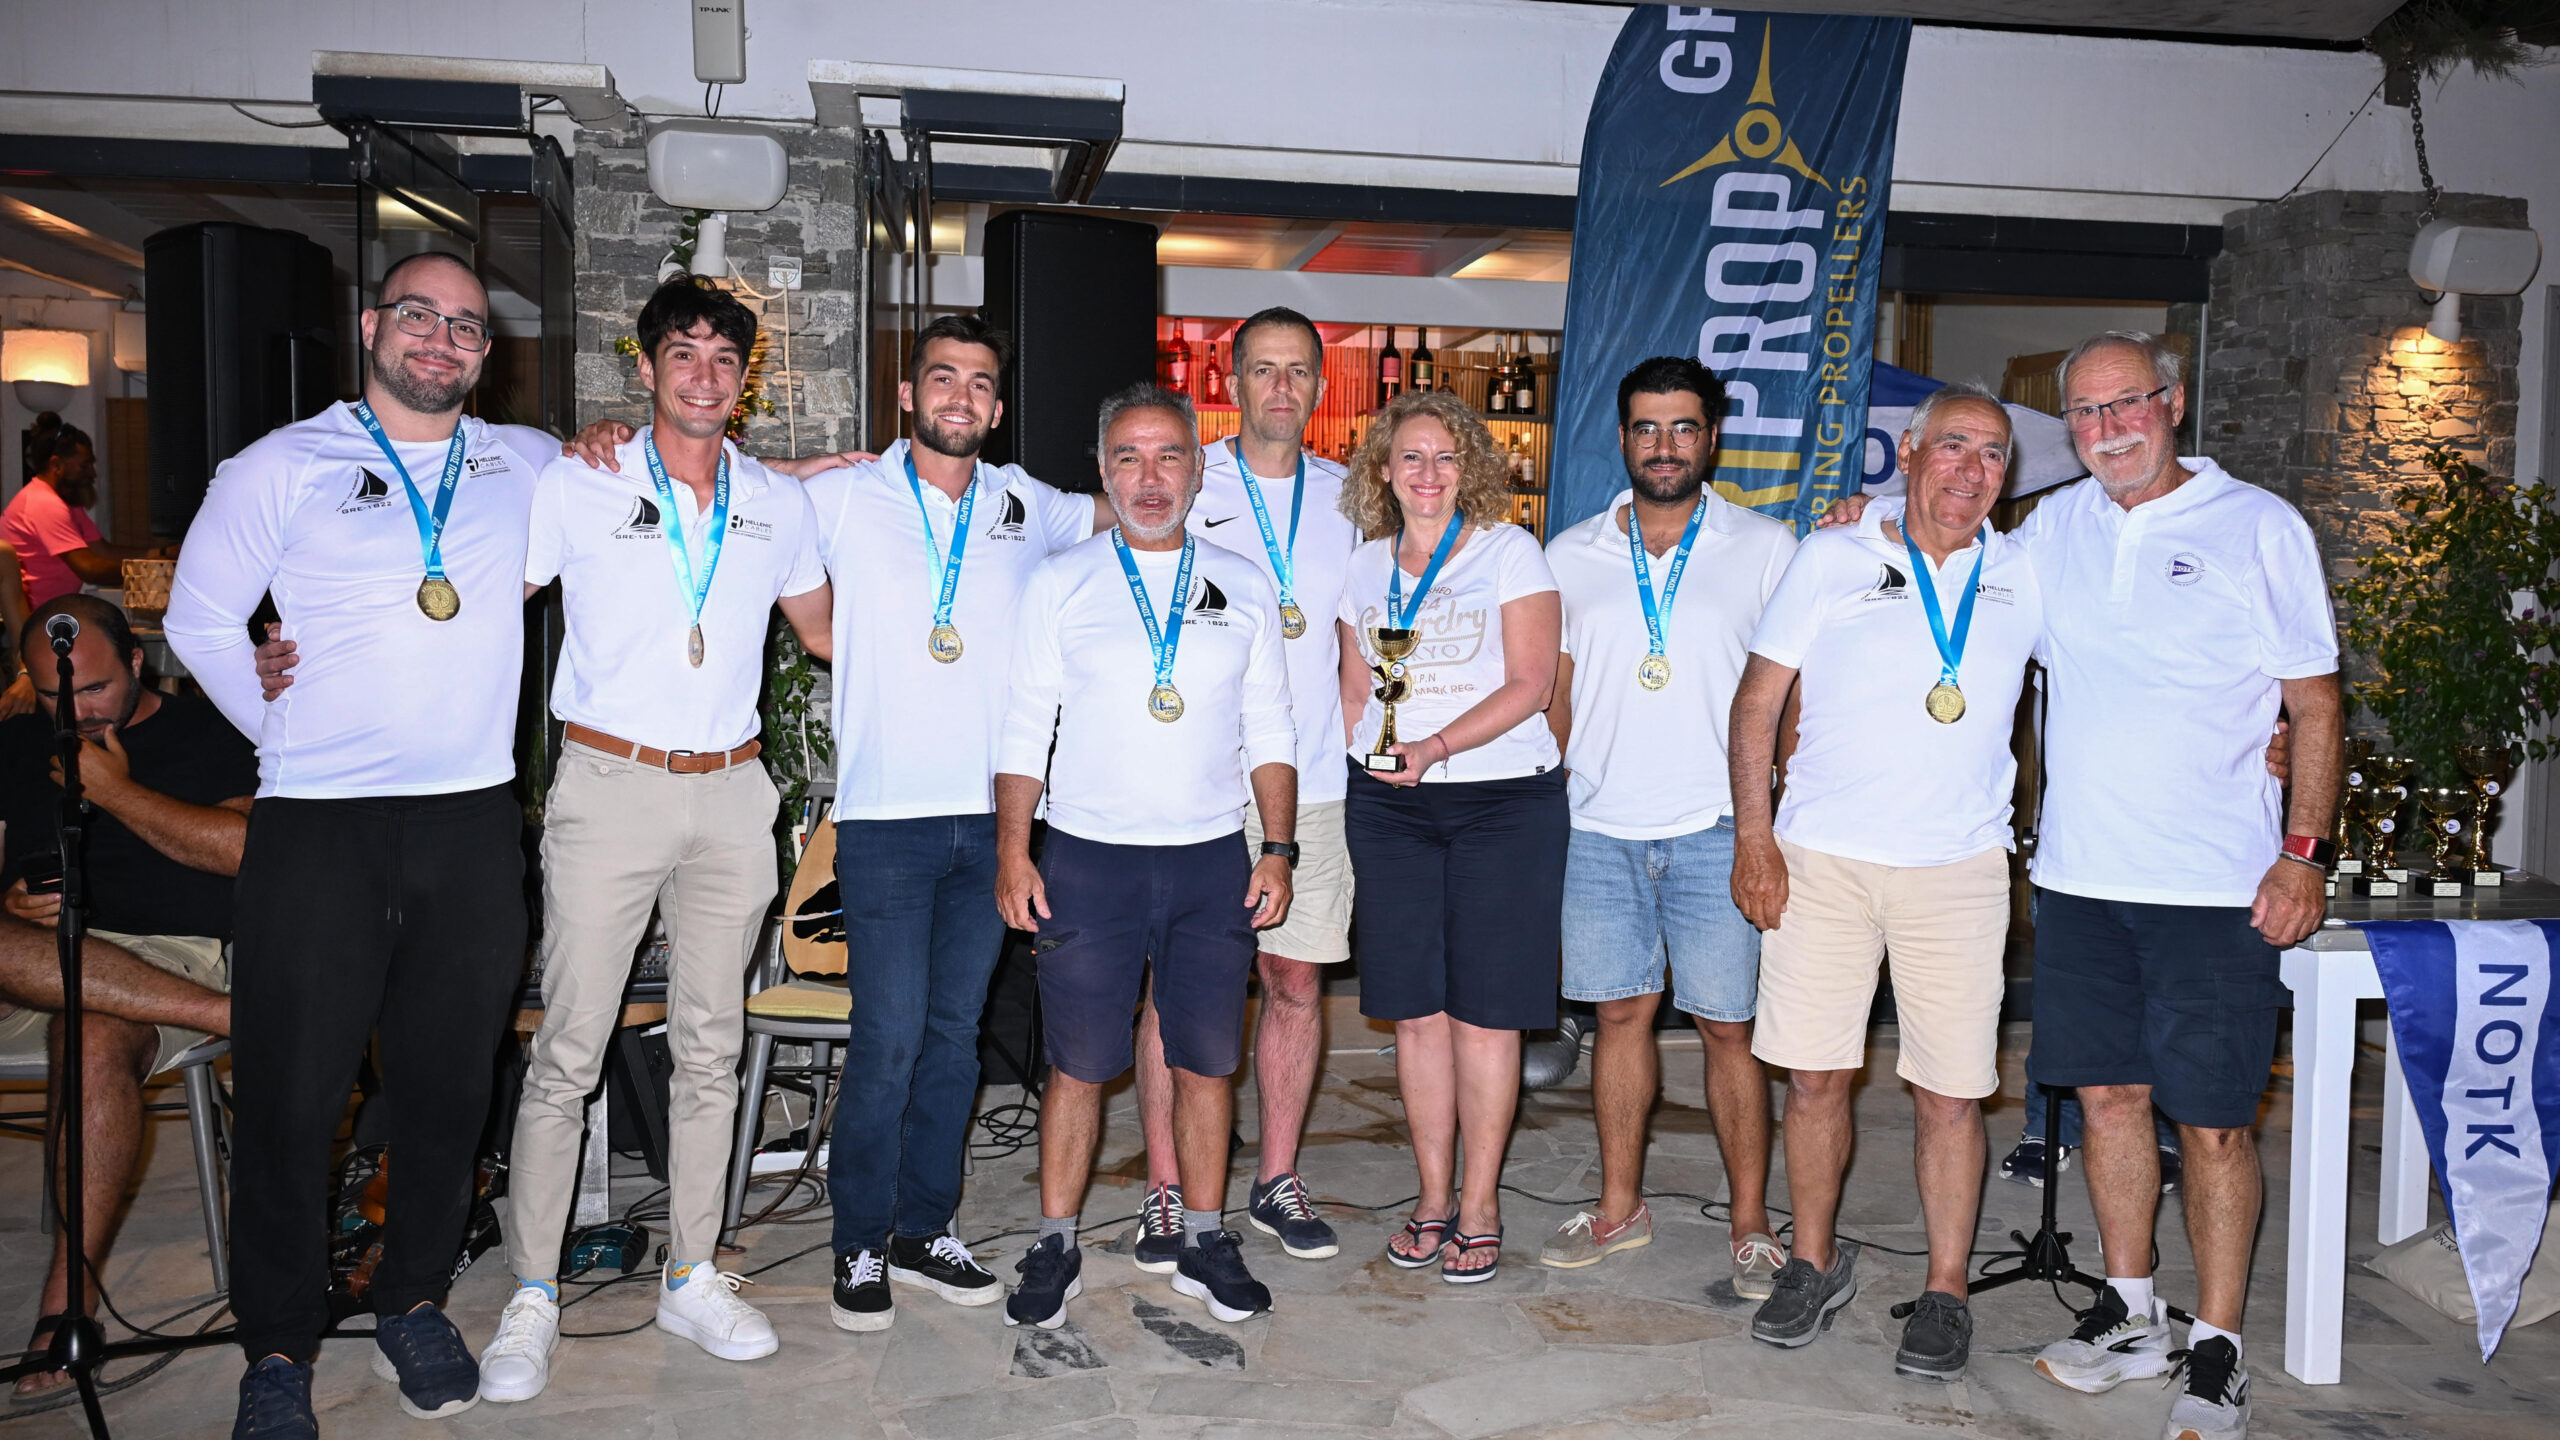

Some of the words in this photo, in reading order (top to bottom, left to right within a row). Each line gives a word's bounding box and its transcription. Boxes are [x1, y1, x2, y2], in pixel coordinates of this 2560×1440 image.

[1819, 176, 1867, 404] PROPELLERS
[745, 519, 773, 529] HELLENIC
[1811, 423, 1843, 532] RING
[2465, 963, 2529, 1161] NOTK
